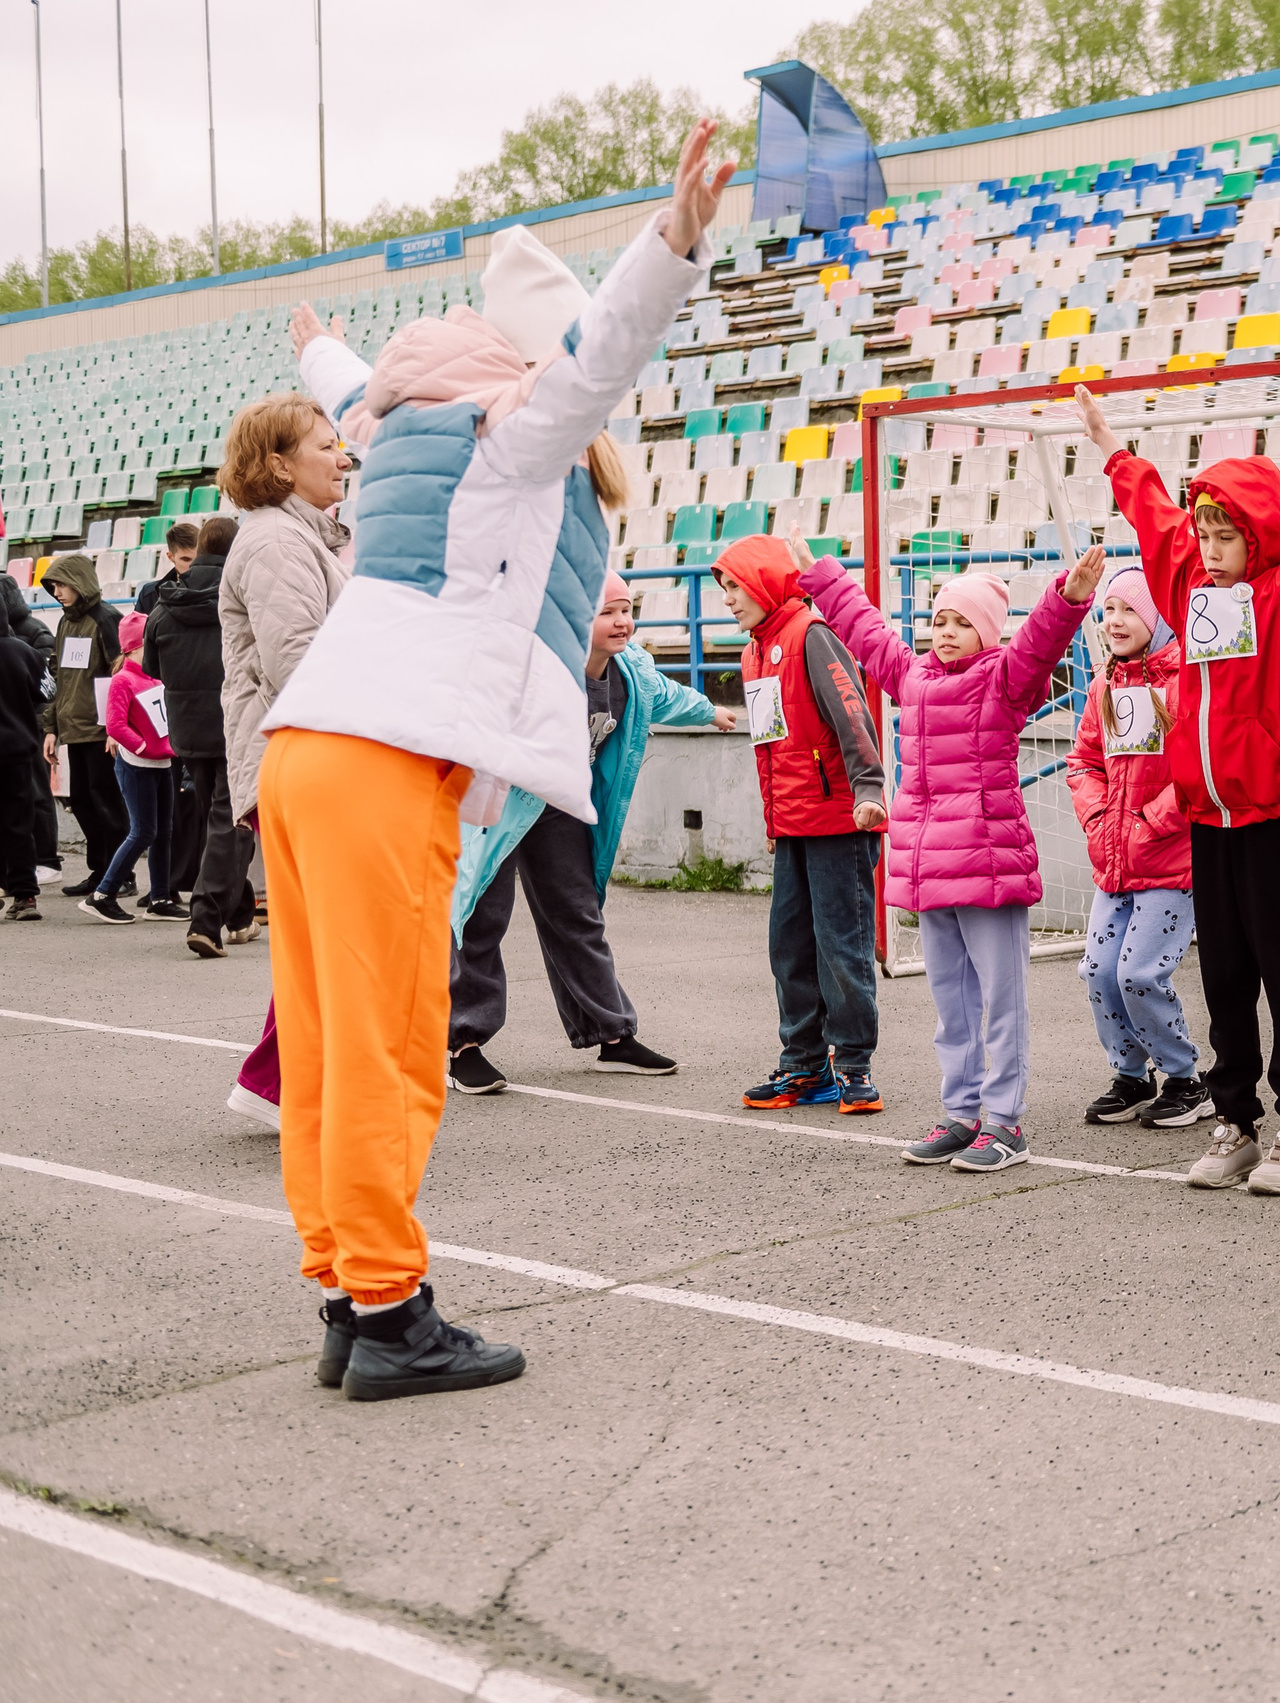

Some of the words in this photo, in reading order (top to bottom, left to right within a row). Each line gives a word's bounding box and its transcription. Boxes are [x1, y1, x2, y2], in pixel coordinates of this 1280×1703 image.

[402, 239, 431, 254] СЕКТОР
[1191, 593, 1218, 644] 8
[70, 651, 84, 662] 105
[747, 687, 761, 729] 7
[827, 662, 863, 715] NIKE
[152, 698, 166, 723] 7
[1114, 695, 1134, 737] 9
